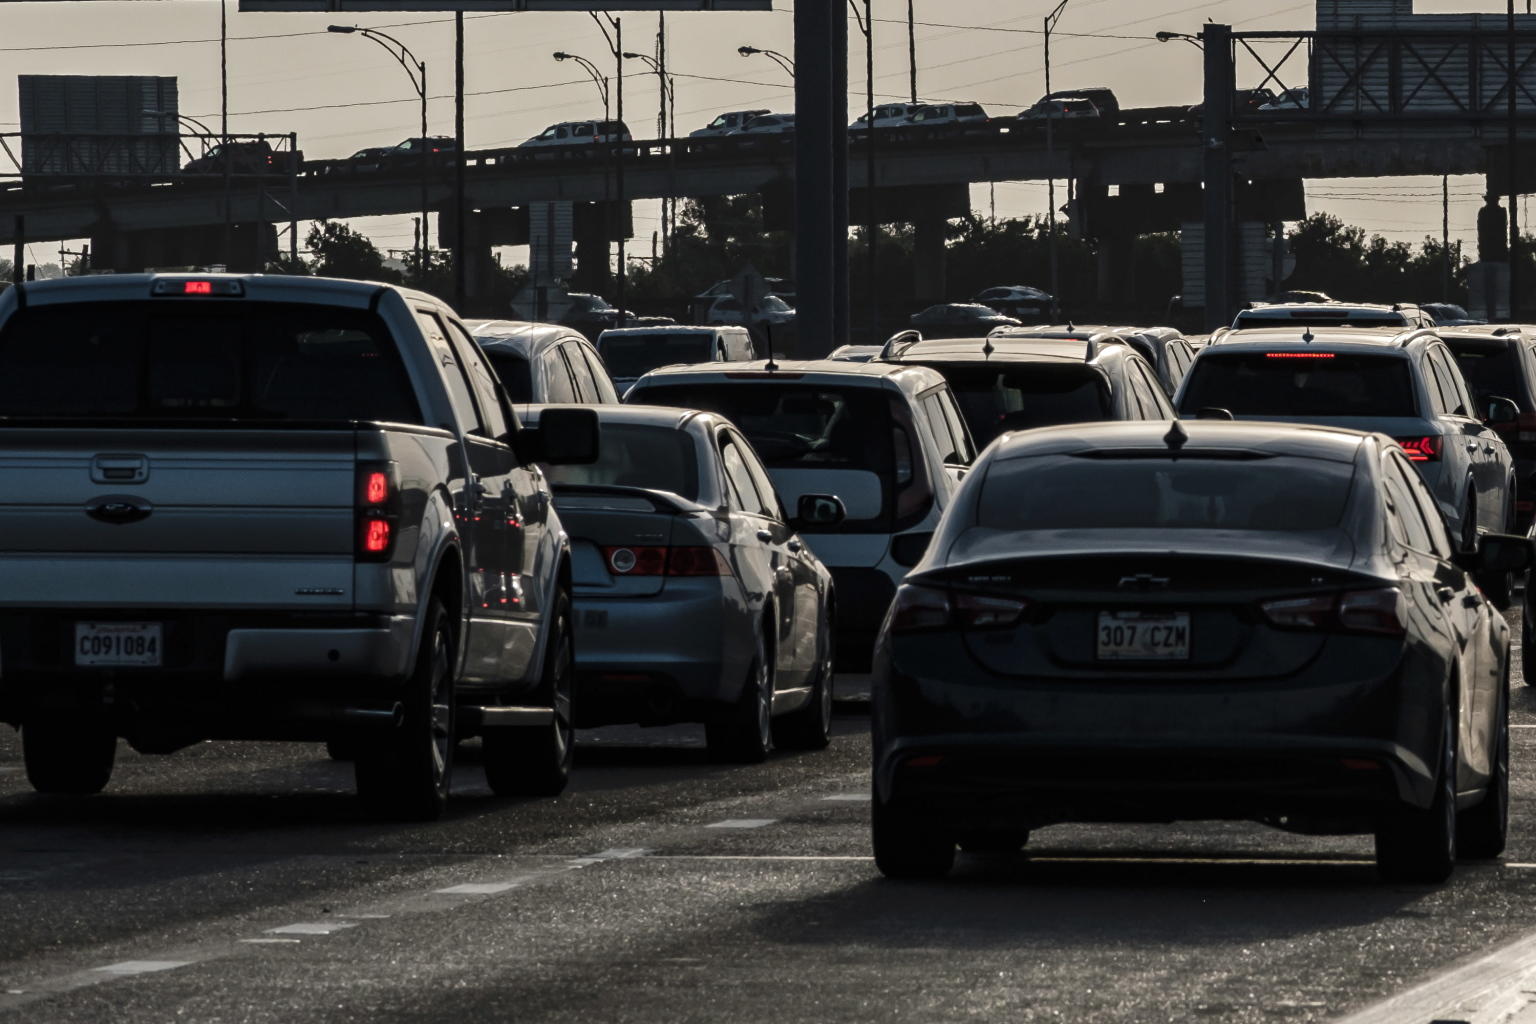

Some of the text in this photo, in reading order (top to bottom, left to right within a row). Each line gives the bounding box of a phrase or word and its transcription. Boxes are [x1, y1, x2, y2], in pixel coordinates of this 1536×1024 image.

[80, 636, 156, 656] C091084
[1101, 625, 1186, 647] 307 CZM
